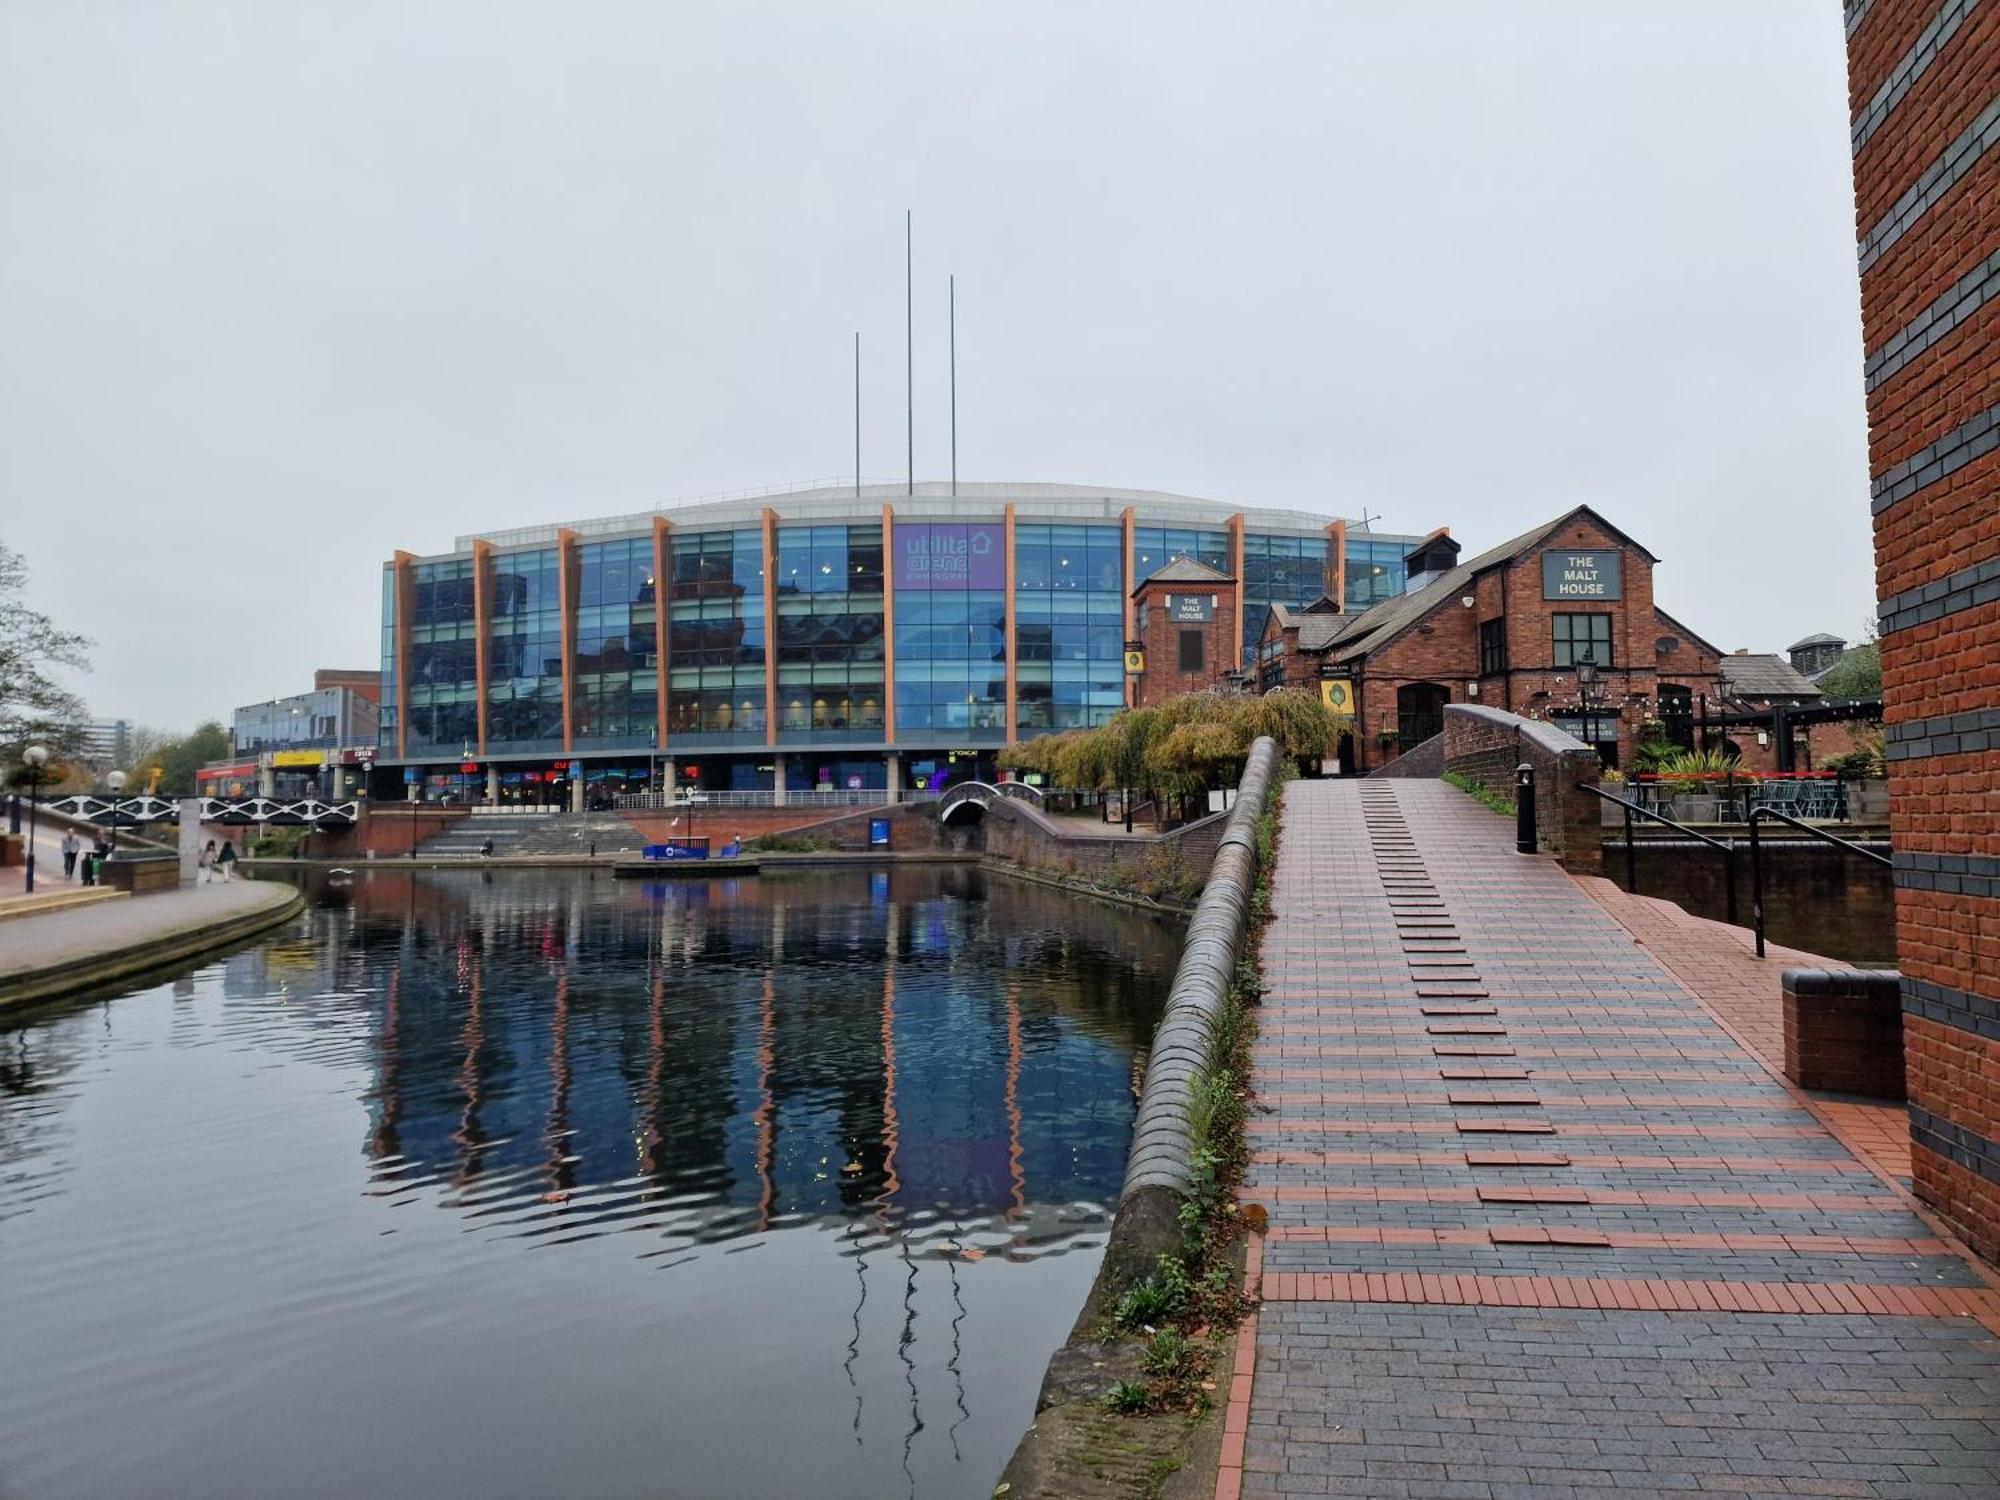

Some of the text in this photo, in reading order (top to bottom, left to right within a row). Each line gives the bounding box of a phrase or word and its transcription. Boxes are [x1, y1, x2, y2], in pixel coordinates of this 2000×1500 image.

[906, 535, 967, 554] utilita
[906, 555, 970, 571] arena
[1568, 557, 1594, 568] THE
[1564, 570, 1599, 581] MALT
[1559, 584, 1605, 594] HOUSE
